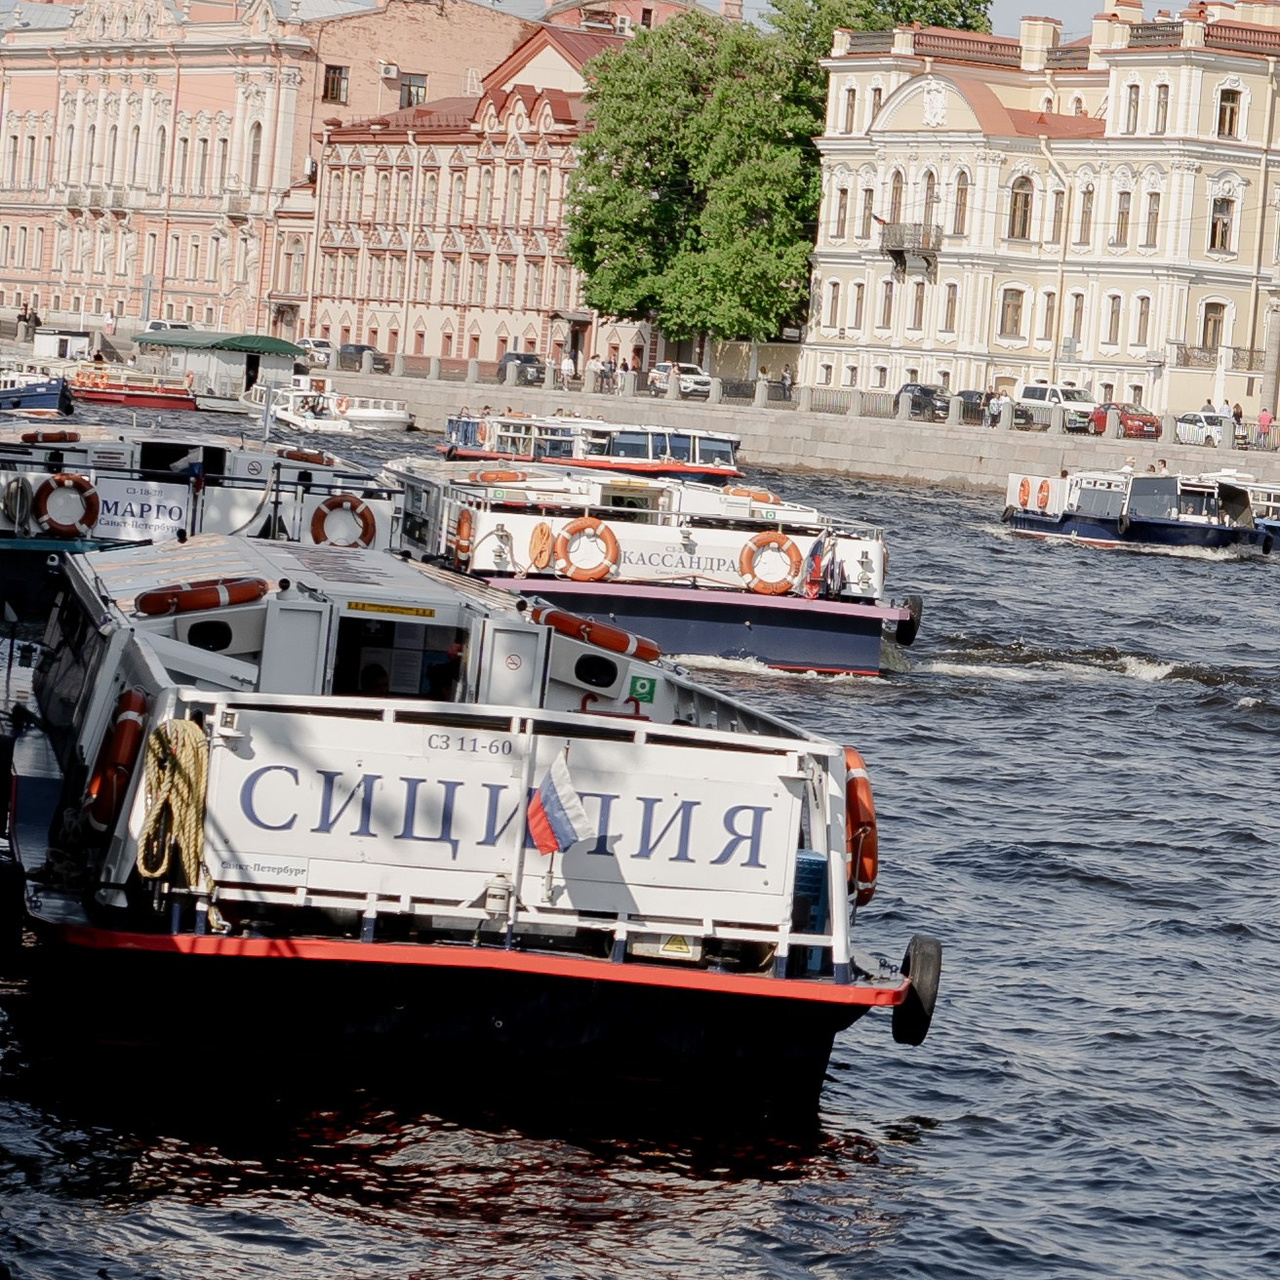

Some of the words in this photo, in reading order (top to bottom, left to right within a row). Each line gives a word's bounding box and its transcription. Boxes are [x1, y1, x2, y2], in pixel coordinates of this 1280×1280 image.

[101, 499, 183, 521] МАРГО
[622, 551, 738, 573] КАССАНДРА
[457, 736, 512, 755] 11-60
